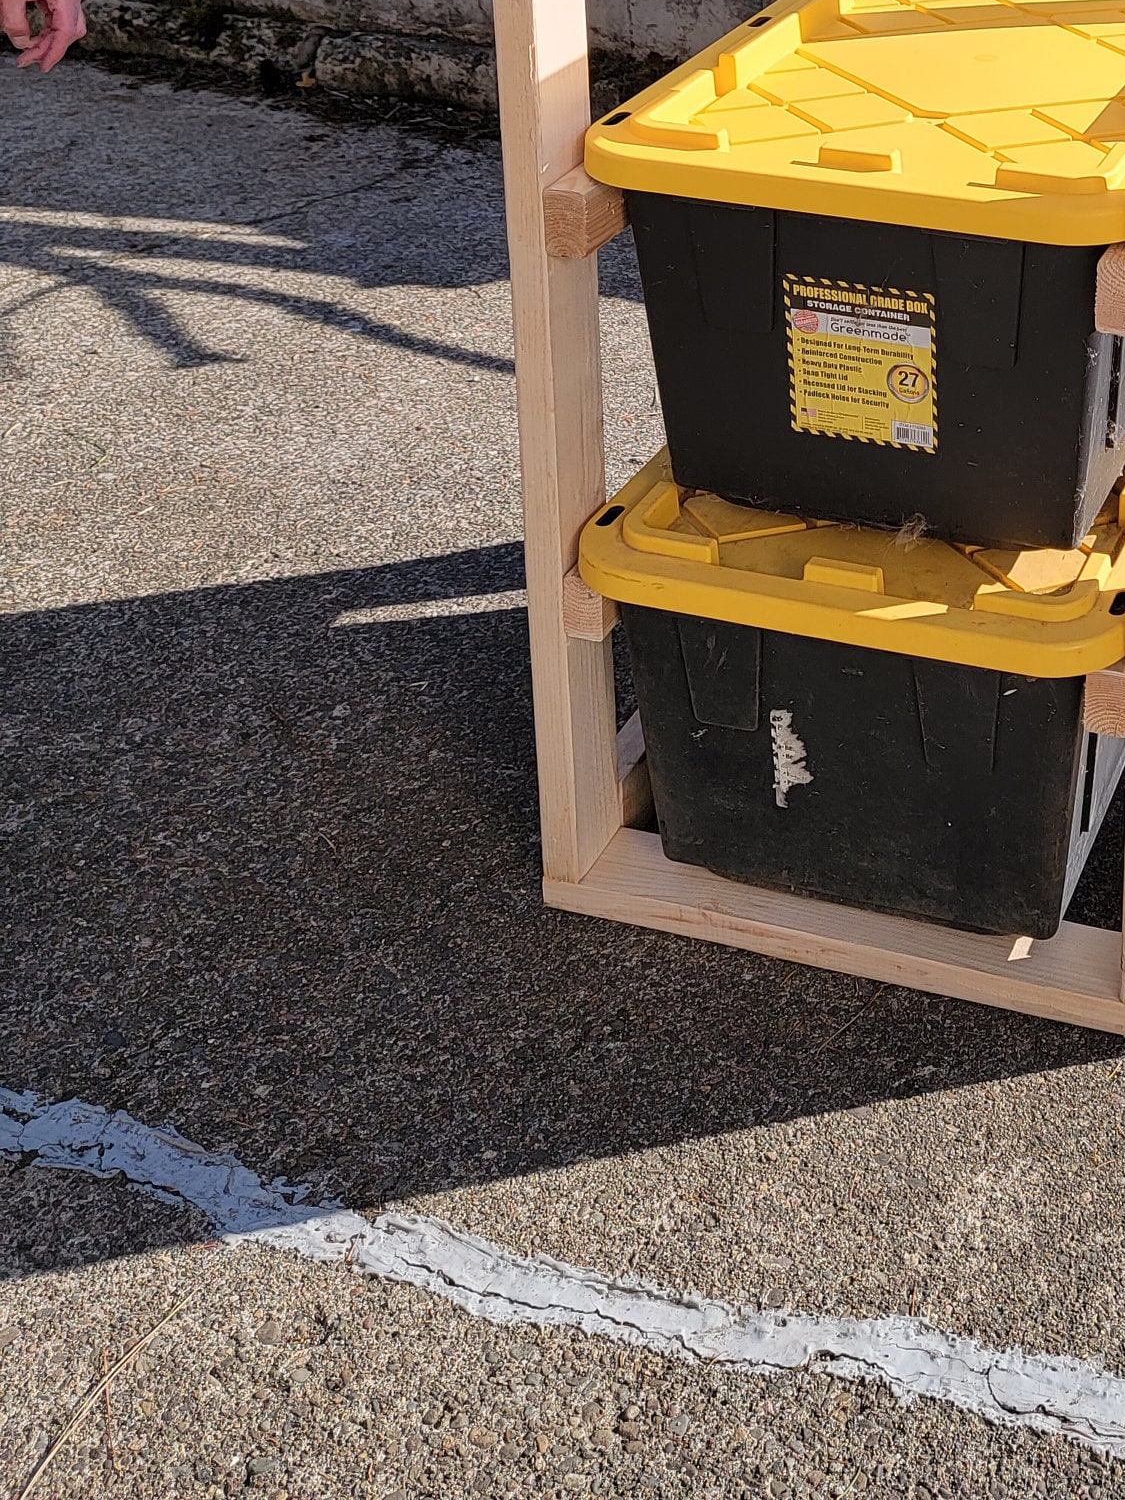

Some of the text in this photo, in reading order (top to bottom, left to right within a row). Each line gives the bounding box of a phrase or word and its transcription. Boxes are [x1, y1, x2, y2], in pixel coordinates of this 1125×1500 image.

[793, 286, 929, 314] PROFESSIONAL GRADE BOX
[806, 300, 910, 322] STORAGE CONTAINER
[830, 322, 907, 342] Greenmade
[801, 337, 914, 361] Designed For Long-Term Durability
[801, 347, 883, 366] Reinforced Construction
[802, 358, 863, 373] Heavy Duty Plastic
[803, 368, 849, 381] Snap Tight Lid
[803, 379, 888, 398] Recessed Lid for Stacking
[898, 370, 920, 388] 27
[803, 389, 890, 409] Padlock Holes for Security
[898, 388, 920, 396] Gallons
